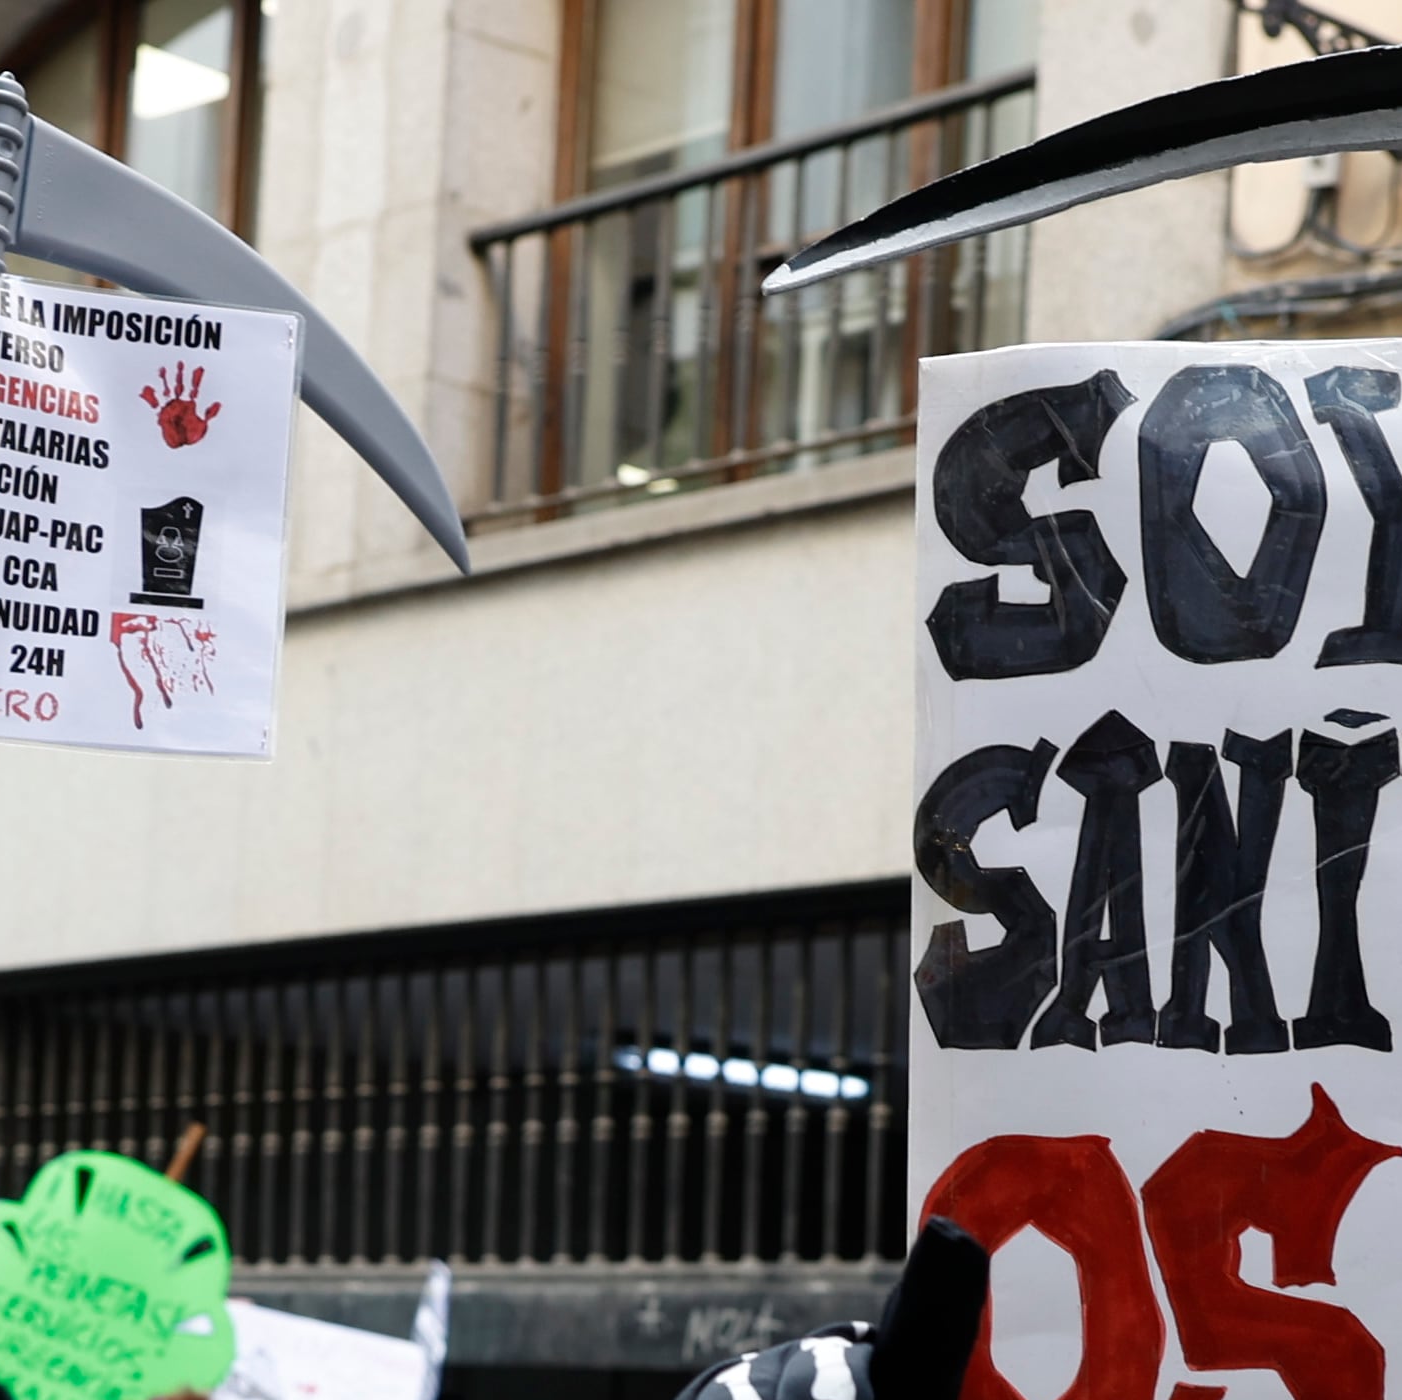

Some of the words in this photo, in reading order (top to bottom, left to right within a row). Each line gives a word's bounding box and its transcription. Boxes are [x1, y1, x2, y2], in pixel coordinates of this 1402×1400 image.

[17, 296, 46, 328] LA
[53, 303, 222, 350] IMPOSICIÓN
[3, 555, 58, 591] CCA
[9, 645, 65, 677] 24H
